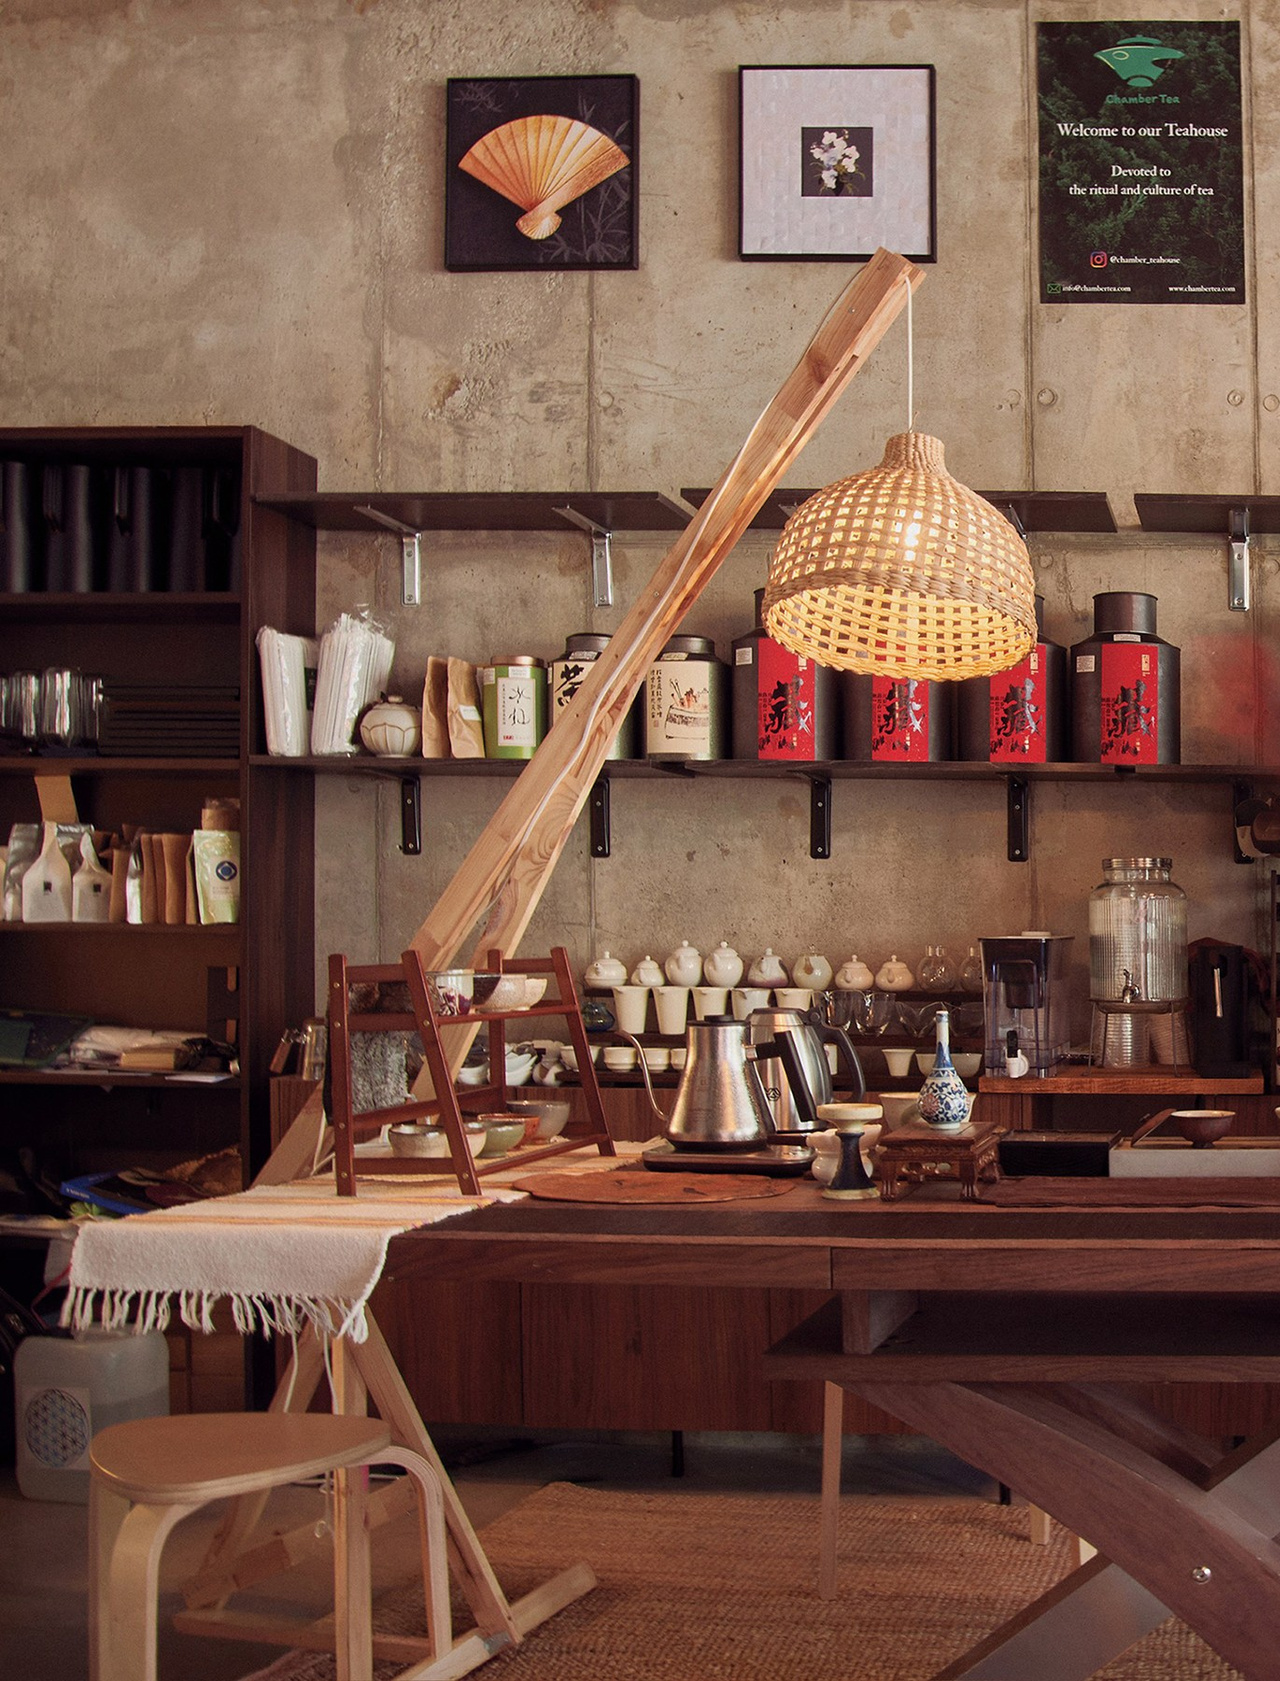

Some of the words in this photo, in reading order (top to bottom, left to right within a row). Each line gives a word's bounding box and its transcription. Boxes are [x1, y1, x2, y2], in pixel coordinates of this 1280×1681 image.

[1106, 94, 1157, 104] Chamber
[1159, 94, 1180, 104] Tea
[1057, 123, 1118, 137] Welcome
[1121, 125, 1135, 137] to
[1138, 126, 1162, 137] our
[1165, 123, 1228, 137] Teahouse
[1111, 165, 1157, 177] Devoted
[1159, 167, 1171, 177] to
[1069, 185, 1087, 195] the
[1089, 184, 1118, 195] ritual
[1120, 184, 1140, 195] and
[1143, 184, 1182, 195] culture
[1183, 184, 1197, 195] of
[1198, 186, 1214, 195] tea
[1110, 255, 1180, 265] @chamber_teahouse
[1062, 284, 1131, 293] info@chambertea.com
[1168, 285, 1236, 293] www.chambertea.com
